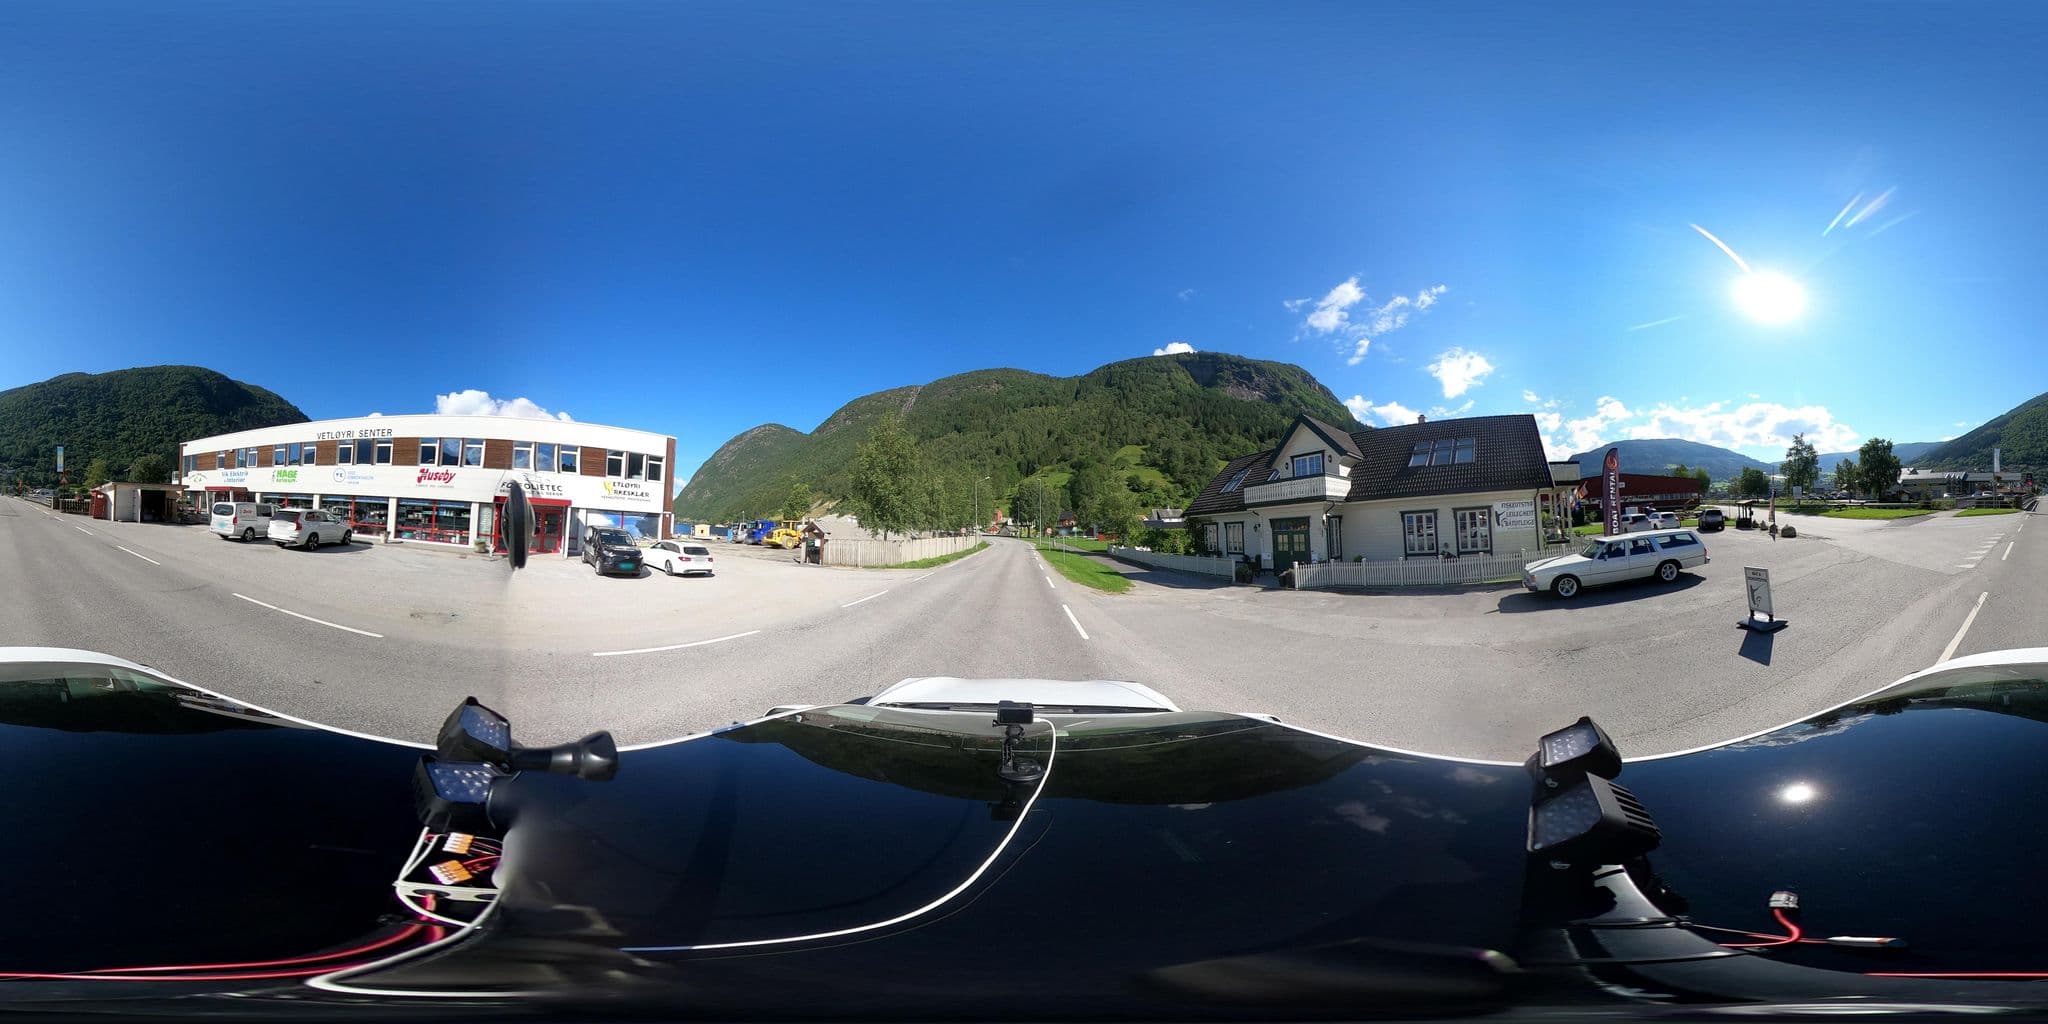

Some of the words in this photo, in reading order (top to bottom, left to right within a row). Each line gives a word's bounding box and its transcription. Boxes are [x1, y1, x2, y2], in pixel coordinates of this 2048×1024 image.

[317, 430, 354, 440] VETLØYRI
[358, 428, 393, 438] SENTER
[276, 469, 298, 479] HAGE
[417, 467, 456, 484] Huseby
[1609, 471, 1617, 507] RENTAL
